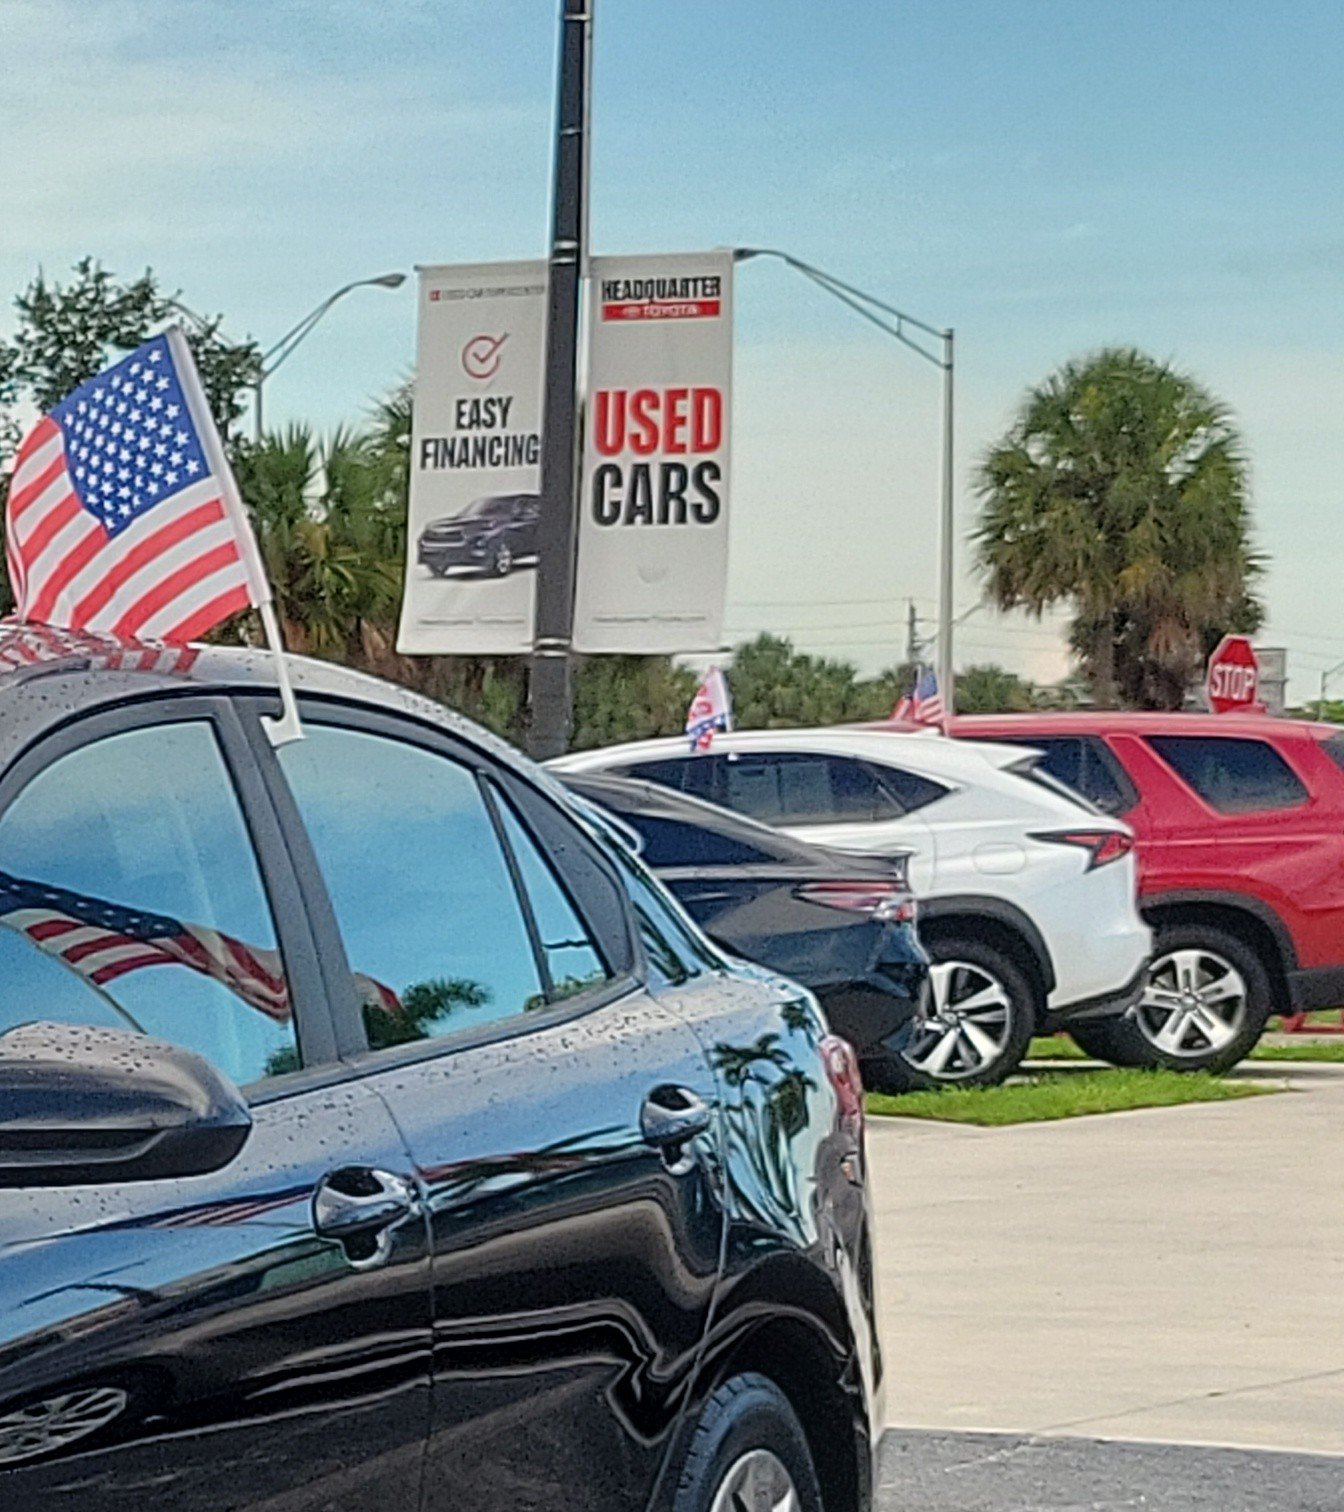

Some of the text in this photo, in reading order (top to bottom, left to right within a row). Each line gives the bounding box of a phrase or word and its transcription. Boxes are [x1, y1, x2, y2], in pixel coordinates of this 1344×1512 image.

[602, 276, 721, 304] HEADQUARTER
[455, 396, 514, 431] EASY
[594, 387, 722, 457] USED
[420, 433, 540, 471] FINANCING
[591, 460, 722, 527] CARS
[1210, 663, 1255, 701] STOP
